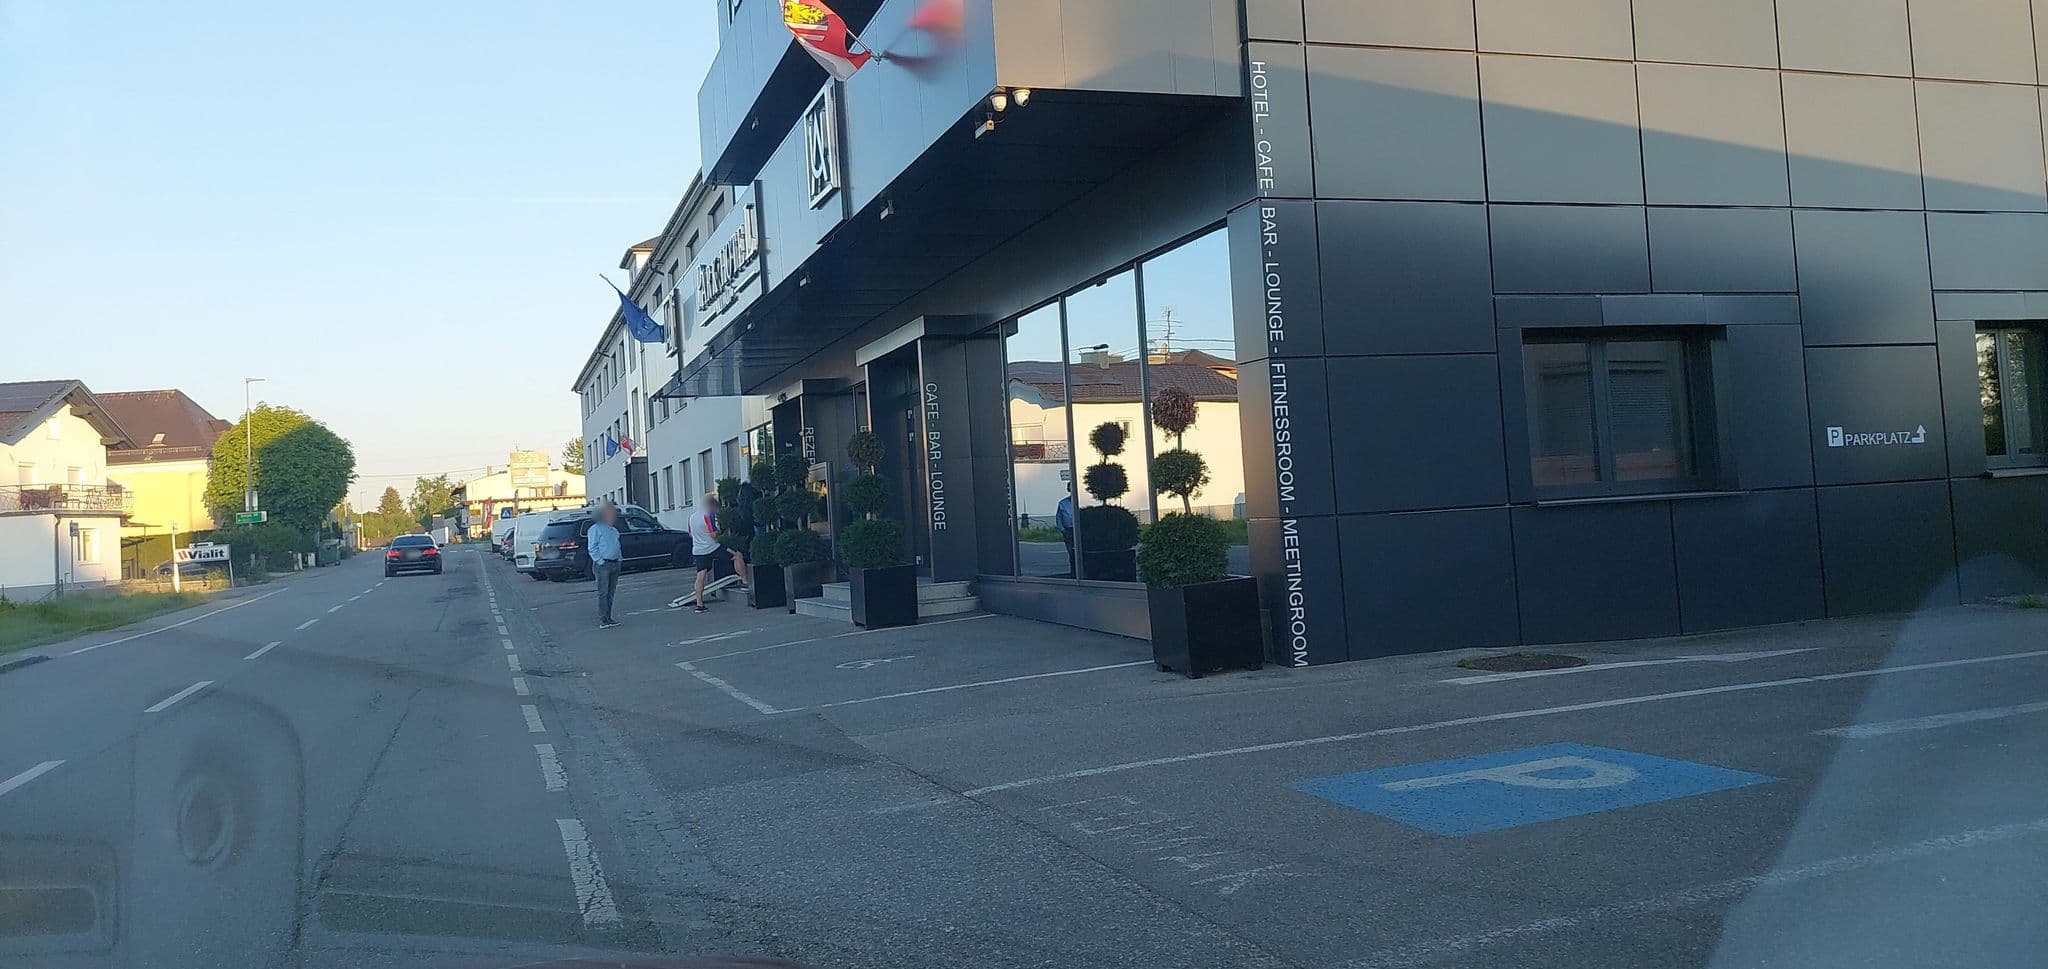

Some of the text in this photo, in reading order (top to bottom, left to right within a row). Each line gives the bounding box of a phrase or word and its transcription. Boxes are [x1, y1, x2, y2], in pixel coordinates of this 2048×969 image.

[1251, 61, 1269, 123] HOTEL
[1261, 207, 1279, 246] BAR
[1265, 262, 1284, 342] LOUNGE
[925, 383, 940, 420] CAFE
[928, 431, 942, 461] BAR
[1271, 363, 1295, 502] FITNESSROOM
[1845, 432, 1911, 446] PARKPLATZ
[930, 471, 947, 531] LOUNGE
[188, 549, 225, 560] Vialit
[1282, 519, 1309, 668] MEETINGROOM
